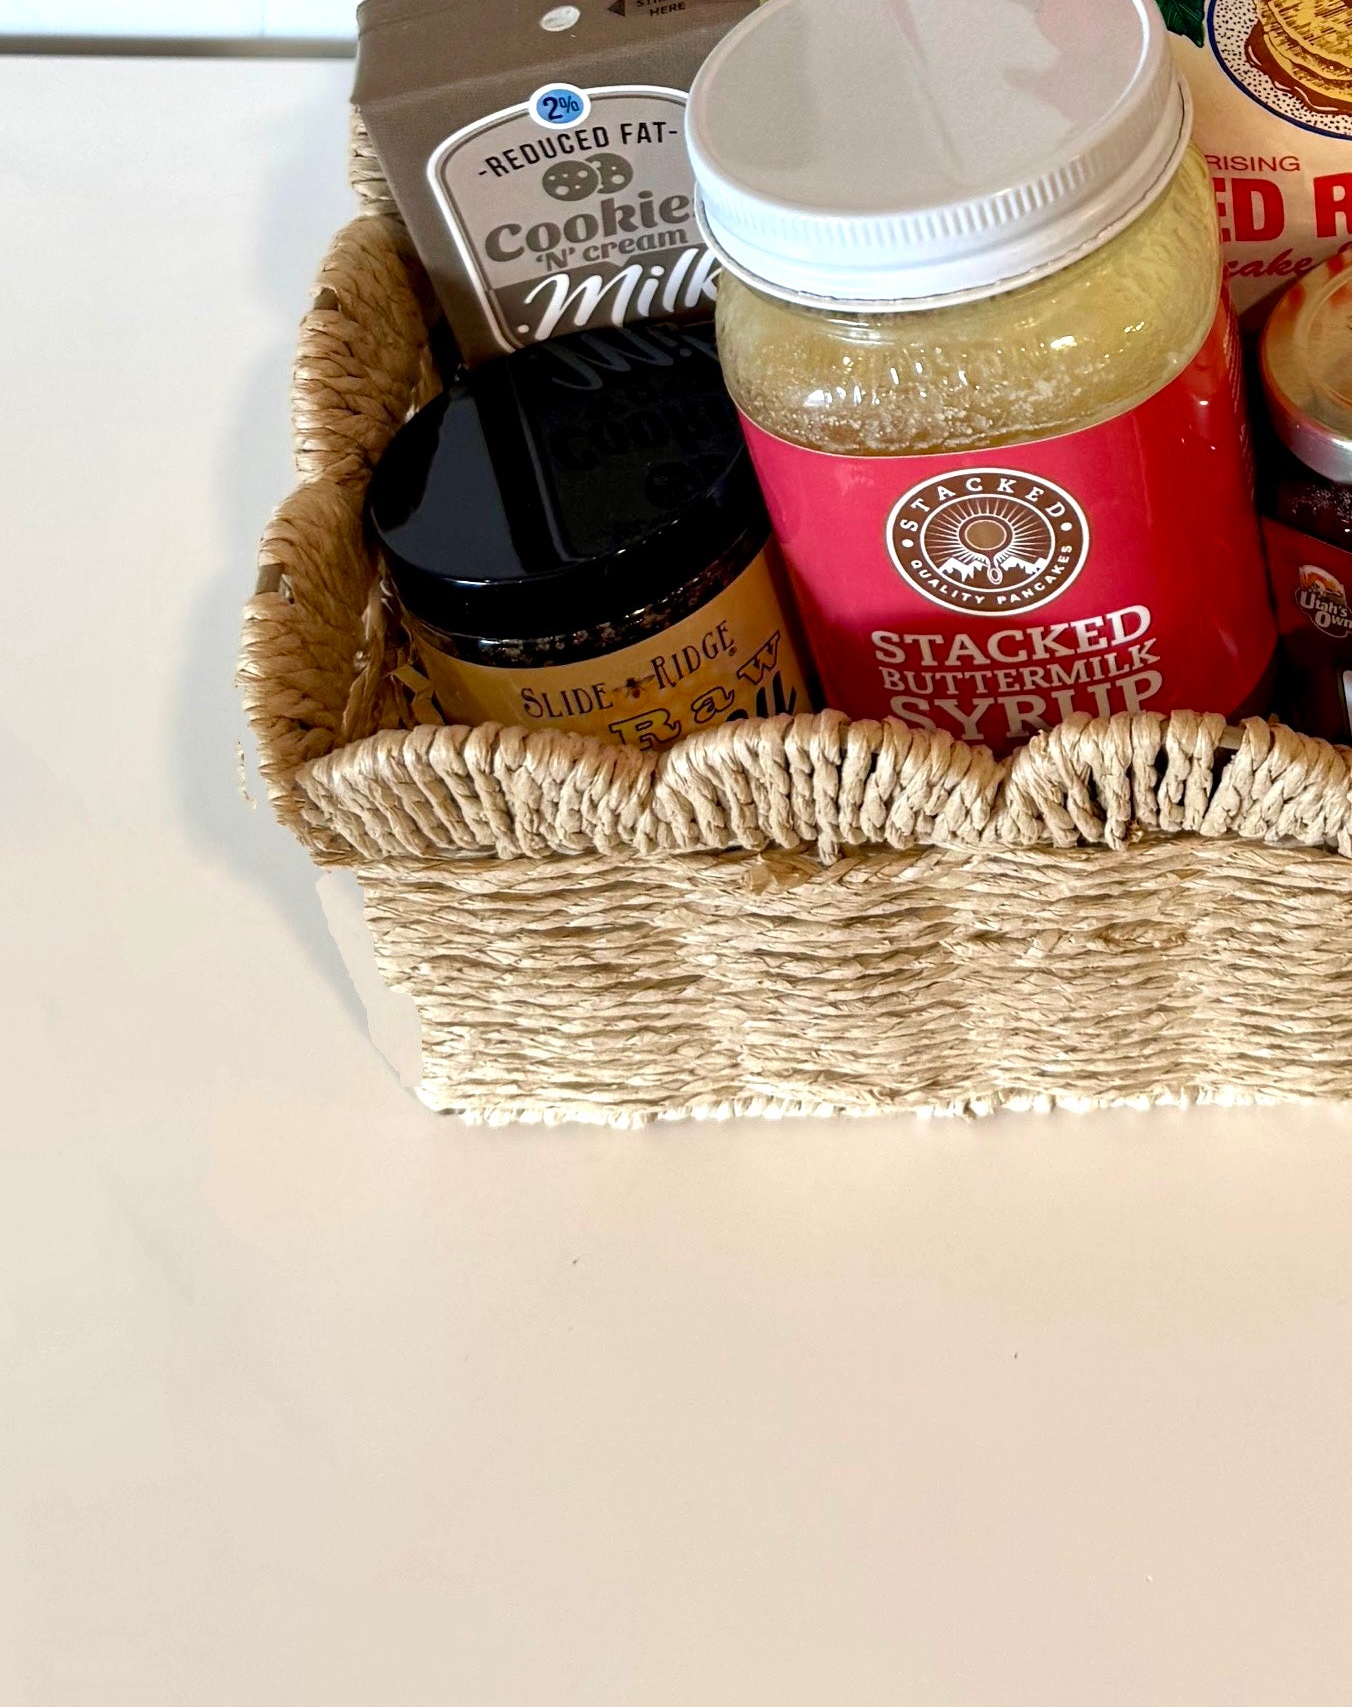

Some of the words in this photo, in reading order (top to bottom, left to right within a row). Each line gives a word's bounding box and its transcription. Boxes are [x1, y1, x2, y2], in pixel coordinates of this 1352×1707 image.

[649, 1, 686, 17] HERE
[542, 93, 581, 122] 2%
[1205, 155, 1301, 173] RISING
[485, 188, 696, 264] Cookie
[583, 226, 690, 261] cream
[899, 477, 1068, 532] STACKED
[909, 558, 987, 605] QUALITY
[996, 543, 1073, 605] PANCAKES
[1299, 589, 1349, 619] Utah's
[869, 604, 1152, 667] STACKED
[520, 683, 614, 719] SLIDE
[649, 619, 735, 690] RIDGE
[609, 629, 782, 751] Raw
[878, 637, 1161, 695] BUTTERMILK
[889, 668, 1164, 741] SYRUP
